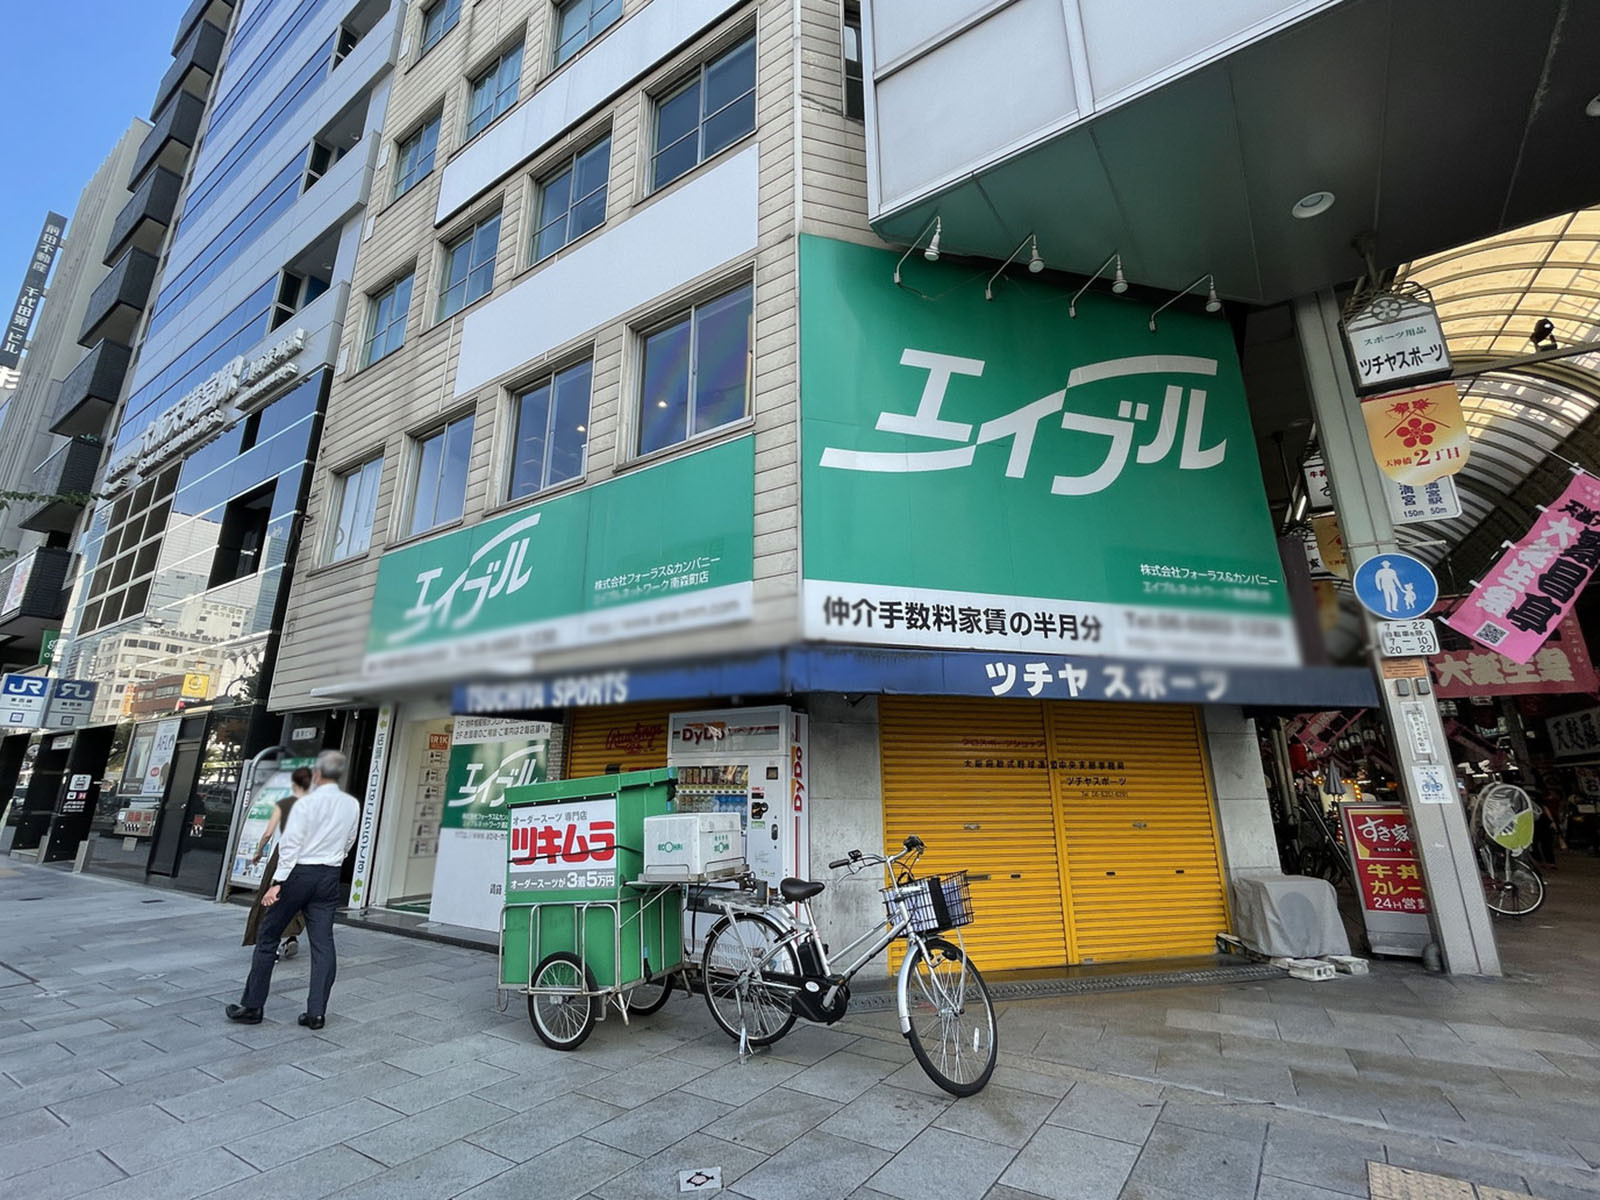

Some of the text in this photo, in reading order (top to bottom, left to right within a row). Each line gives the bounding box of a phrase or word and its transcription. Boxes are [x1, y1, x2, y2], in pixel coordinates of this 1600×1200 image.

[4, 286, 39, 354] 千代田第一ビル
[1364, 326, 1427, 346] スポーツ用品
[1359, 343, 1443, 376] ツチヤスポーツ
[819, 348, 1227, 495] エイブル
[1403, 509, 1425, 518] 150m
[1430, 506, 1447, 515] 50m
[385, 513, 542, 642] エイブル
[823, 597, 1103, 643] 仲介手数料家賃の半月分
[8, 680, 43, 694] JR
[551, 671, 629, 707] SPORTS
[985, 661, 1088, 698] ツチヤ
[682, 727, 725, 745] DyDo
[794, 746, 805, 811] DyDo
[1066, 775, 1127, 786] ツチヤスポーツ
[513, 813, 562, 825] オーダースーツ
[564, 811, 588, 821] 専門店
[1357, 816, 1410, 846] すき家
[511, 821, 615, 865] ツキムラ
[1367, 863, 1419, 879] 牛丼
[1370, 880, 1421, 895] カレー
